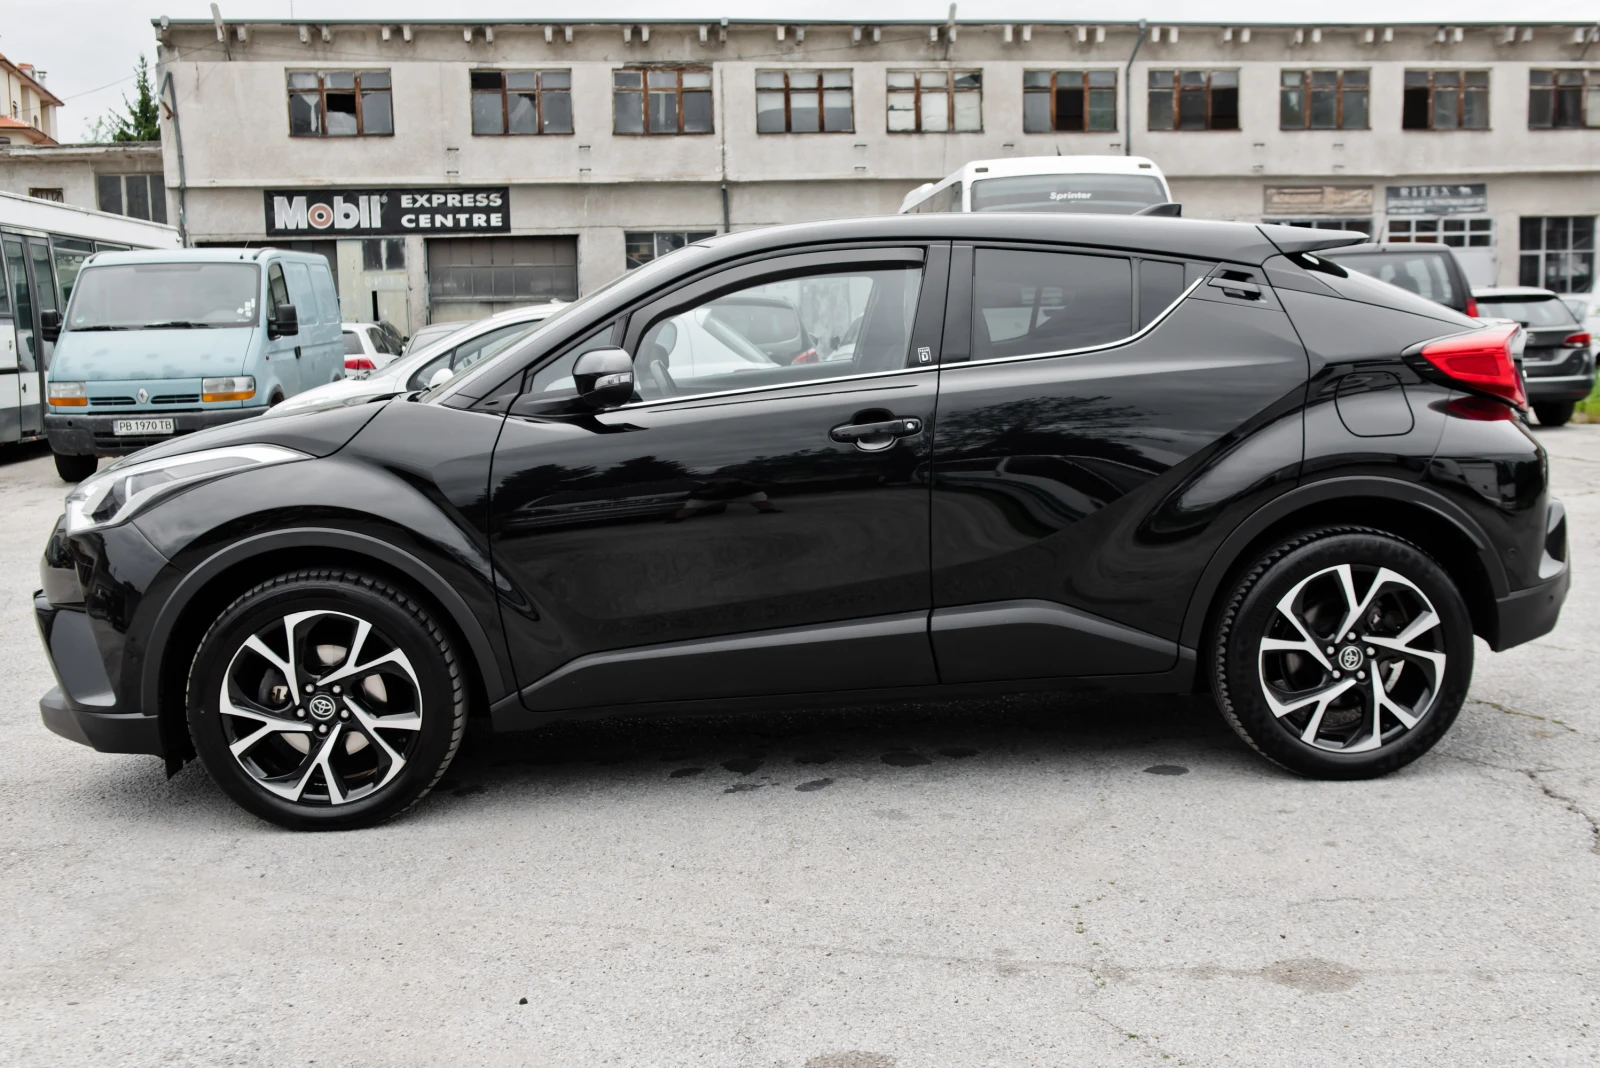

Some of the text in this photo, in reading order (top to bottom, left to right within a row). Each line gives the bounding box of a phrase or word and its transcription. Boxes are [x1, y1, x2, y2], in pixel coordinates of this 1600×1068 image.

[400, 193, 503, 208] EXPRESS
[1049, 191, 1092, 201] Sprinter
[400, 213, 503, 228] CENTRE
[119, 420, 172, 431] PB 1970 TB
